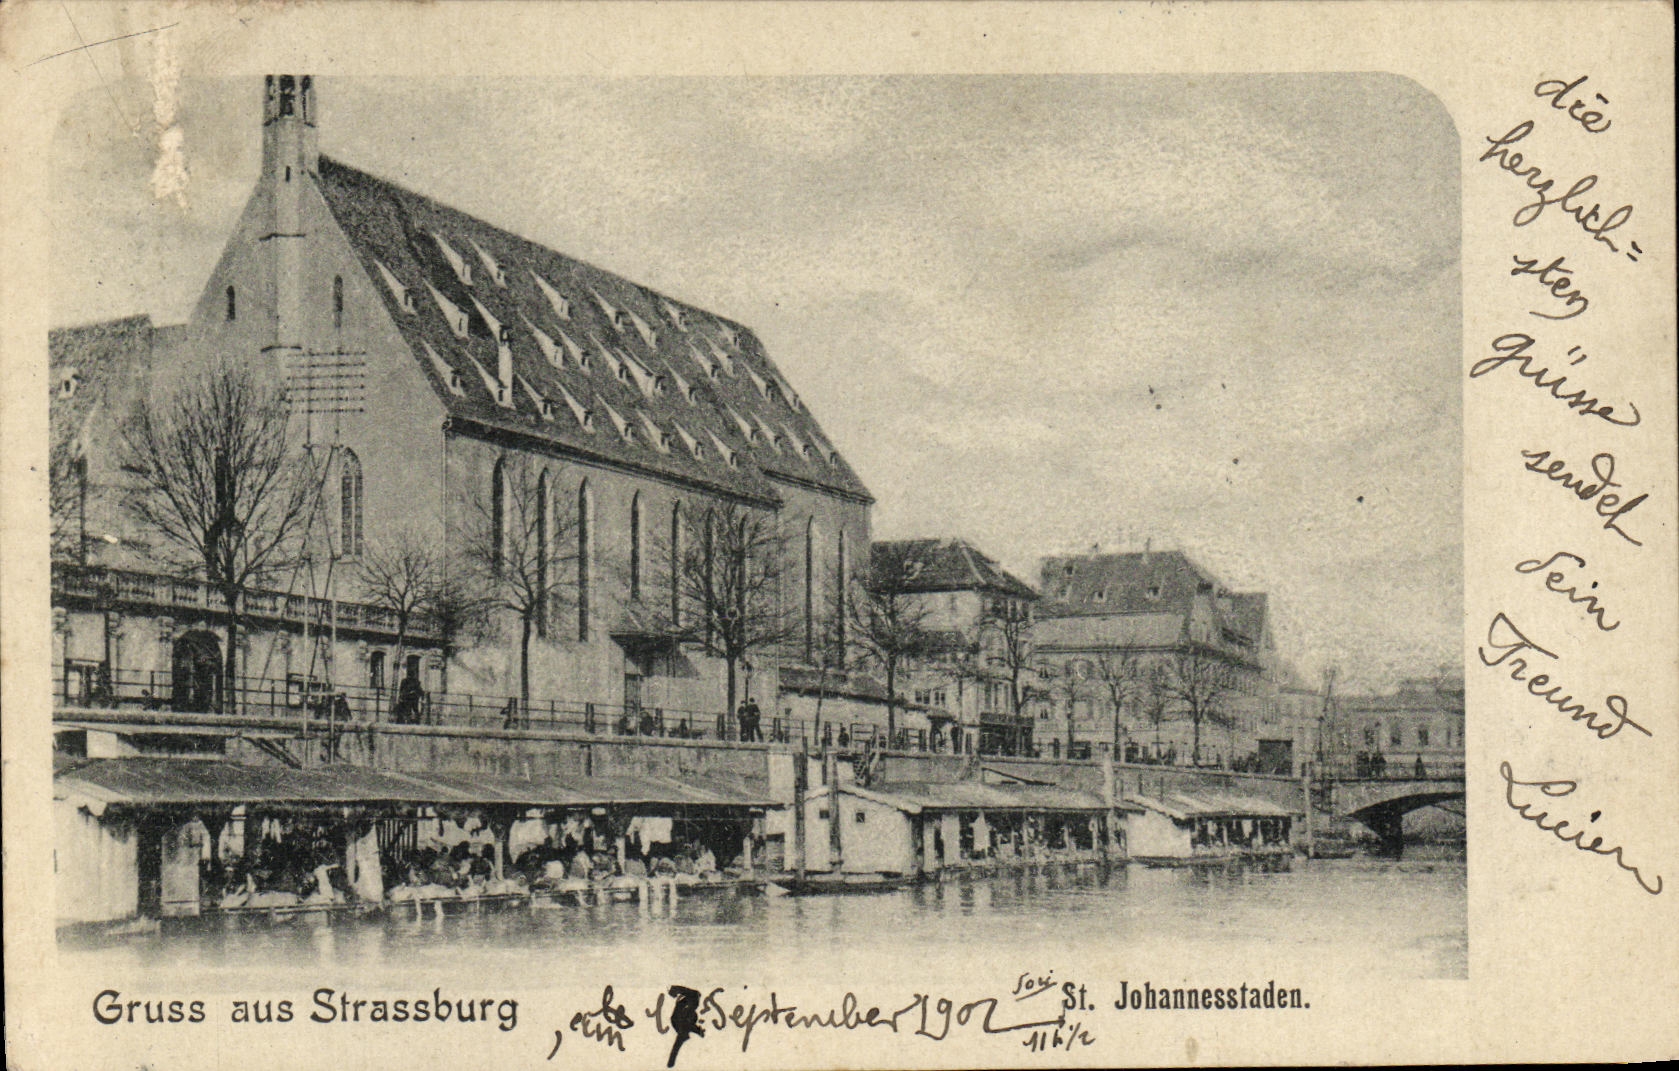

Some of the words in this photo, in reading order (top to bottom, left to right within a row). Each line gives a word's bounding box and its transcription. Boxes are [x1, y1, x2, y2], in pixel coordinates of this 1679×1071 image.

[1534, 75, 1612, 134] die
[1510, 253, 1589, 321] sten
[1500, 761, 1663, 896] Lucien
